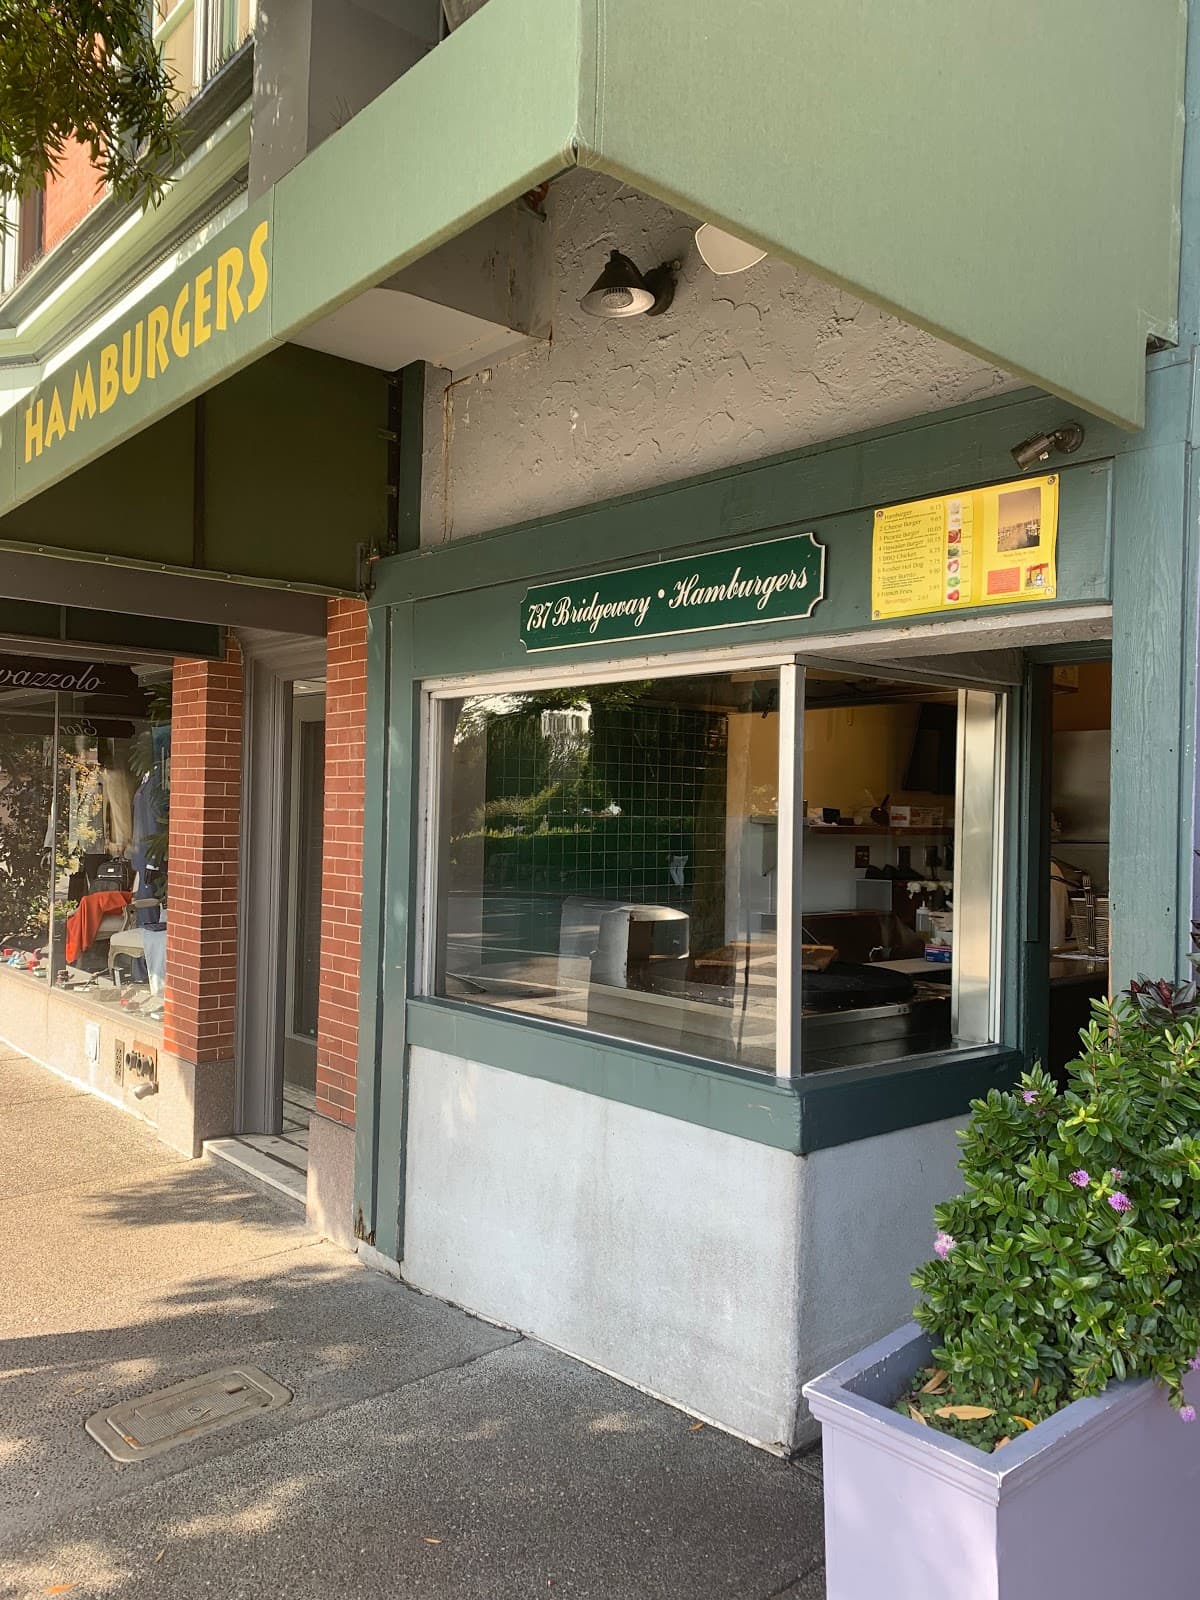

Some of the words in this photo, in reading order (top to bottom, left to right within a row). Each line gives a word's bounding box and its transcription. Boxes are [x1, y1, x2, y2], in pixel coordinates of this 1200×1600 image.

[25, 220, 268, 463] HAMBURGERS
[526, 601, 553, 632] 737
[552, 591, 651, 634] Bridgeway
[668, 566, 809, 610] Hamburgers
